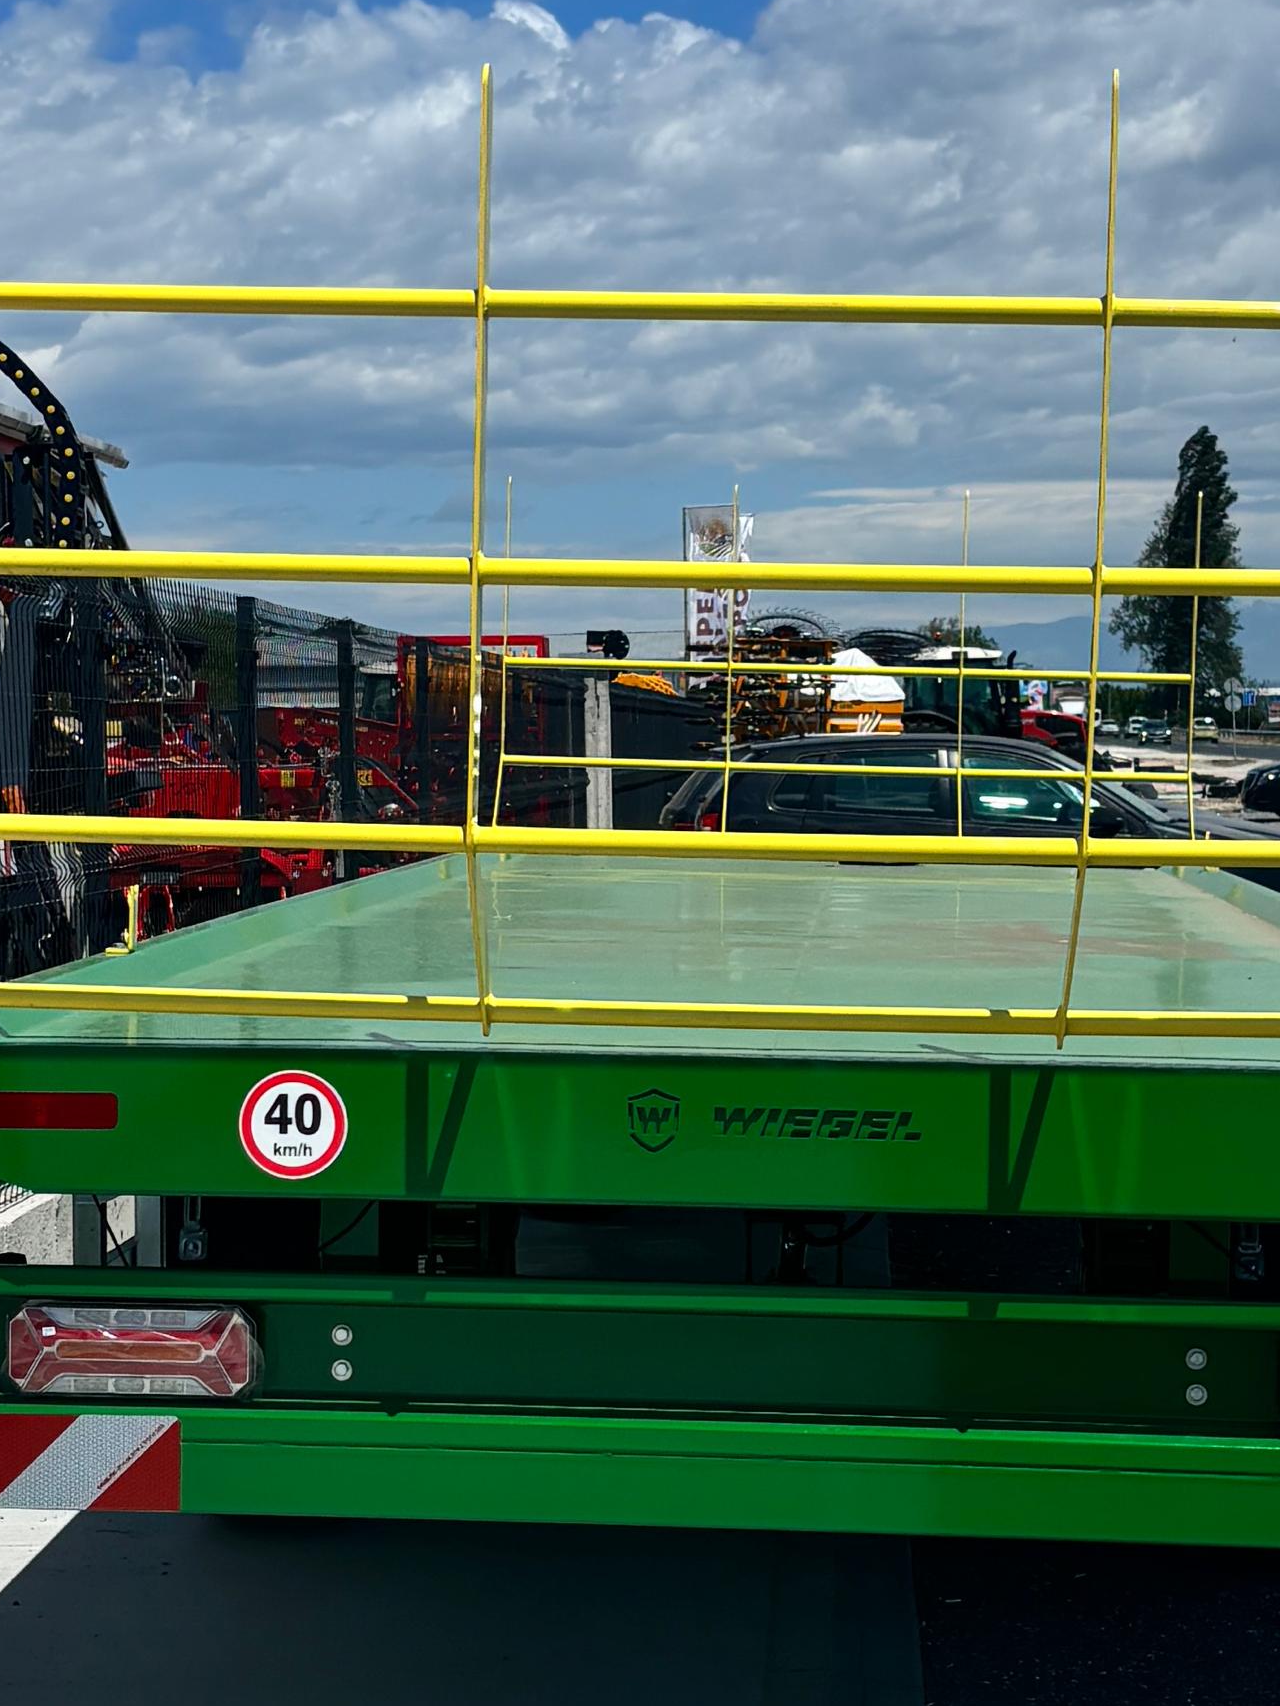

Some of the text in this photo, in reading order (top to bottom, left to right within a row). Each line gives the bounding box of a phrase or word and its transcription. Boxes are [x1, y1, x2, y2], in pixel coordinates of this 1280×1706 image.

[264, 1093, 322, 1135] 40
[713, 1106, 922, 1142] WIEGEL
[273, 1142, 313, 1157] km/h
